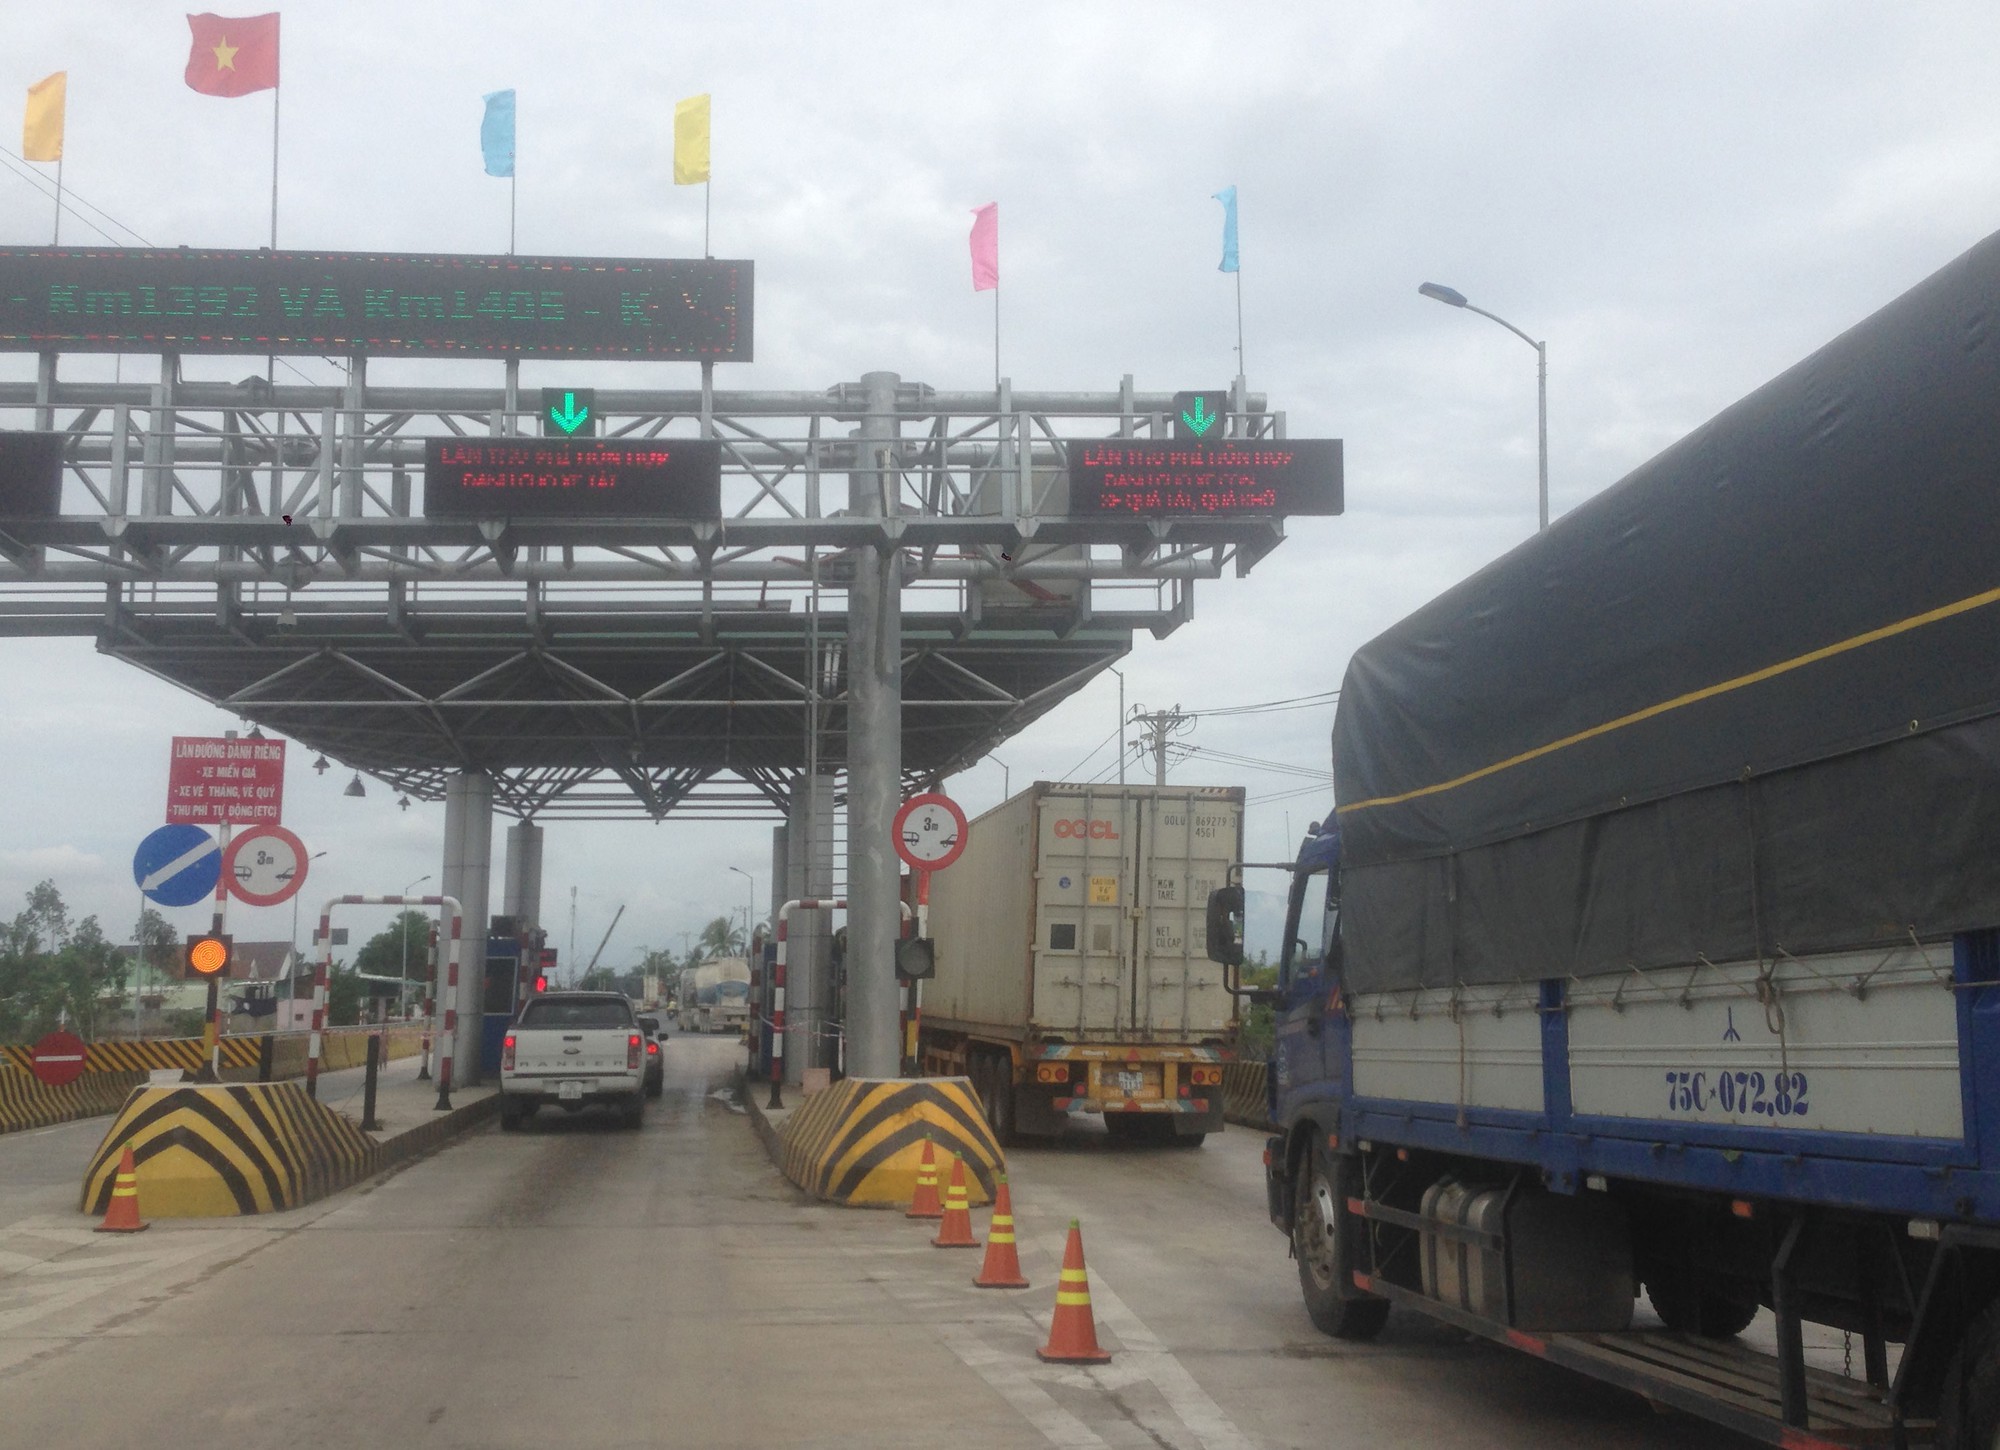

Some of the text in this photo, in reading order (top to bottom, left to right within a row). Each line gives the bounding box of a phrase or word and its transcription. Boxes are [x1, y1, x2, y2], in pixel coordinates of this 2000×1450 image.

[176, 741, 195, 758] LÀN
[254, 743, 281, 760] RIÊNG
[201, 766, 214, 778] XE
[179, 785, 191, 797] XE
[173, 805, 191, 816] THU
[1164, 815, 1186, 826] OOLU
[1054, 819, 1119, 840] OOCL
